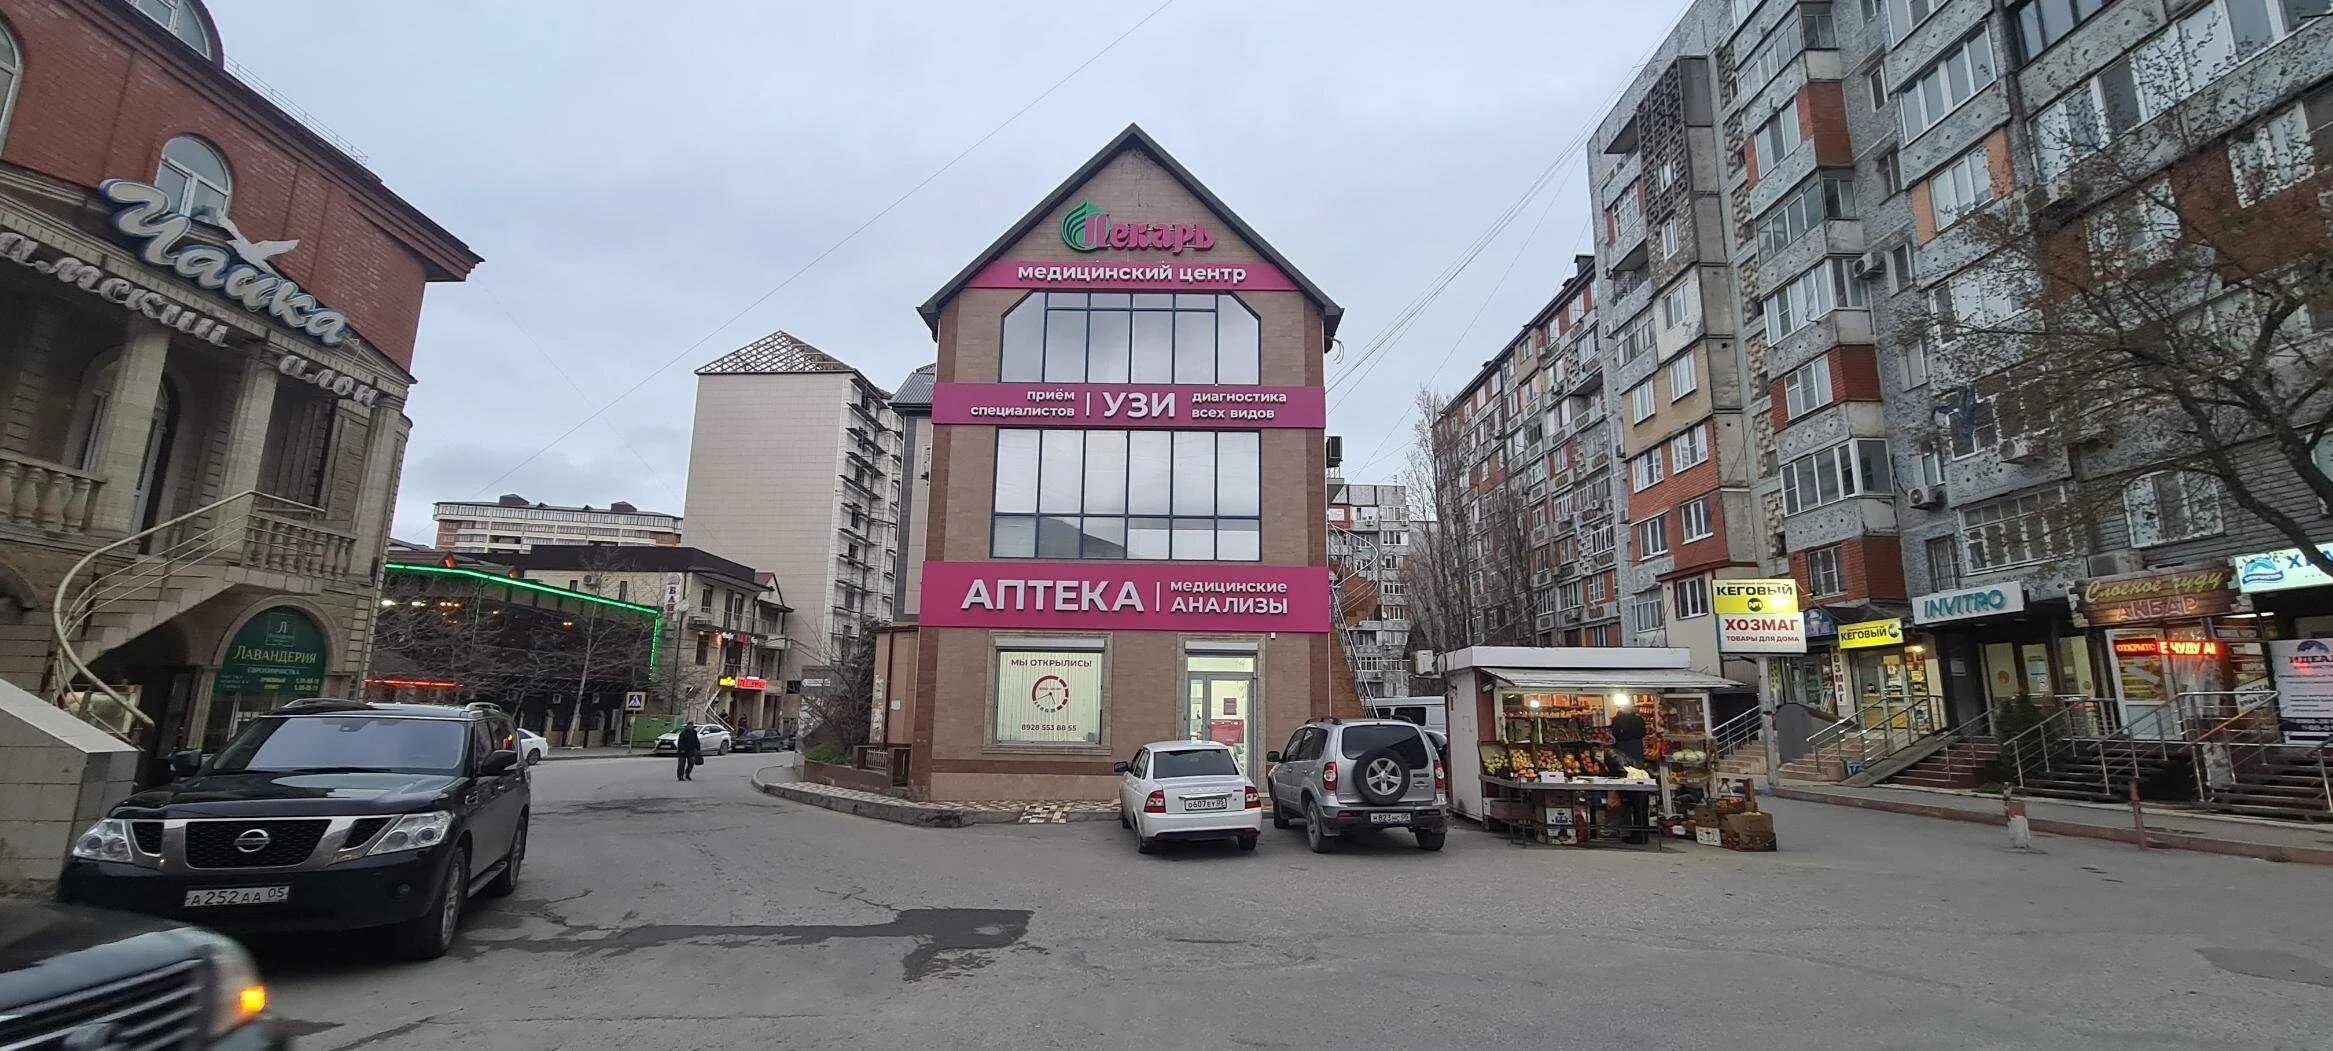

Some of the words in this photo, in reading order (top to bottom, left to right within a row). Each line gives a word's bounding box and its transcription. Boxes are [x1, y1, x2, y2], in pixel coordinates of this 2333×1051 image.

[1082, 213, 1216, 256] Лекарь
[1018, 264, 1173, 283] медицинский
[1179, 267, 1247, 284] центр
[1027, 389, 1075, 402] приём
[1192, 392, 1287, 404] диагностика
[1102, 391, 1177, 418] УЗИ
[970, 406, 1075, 418] специалистов
[1192, 408, 1225, 419] всех
[1231, 408, 1275, 420] видов
[1170, 581, 1288, 594] медицинские
[1716, 584, 1793, 596] КЕГОВЫЙ
[961, 579, 1145, 613] АПТЕКА
[1170, 597, 1288, 615] АНАЛИЗЫ
[1725, 618, 1799, 631] ХОЗМАГ
[1759, 635, 1776, 643] ДЛЯ
[1777, 635, 1799, 643] ДОМА
[1841, 626, 1887, 641] КЕГОВЫЙ
[1011, 659, 1028, 667] МЫ
[1030, 659, 1092, 668] ОТКРЫЛИСЬ!
[1068, 724, 1077, 732] 55
